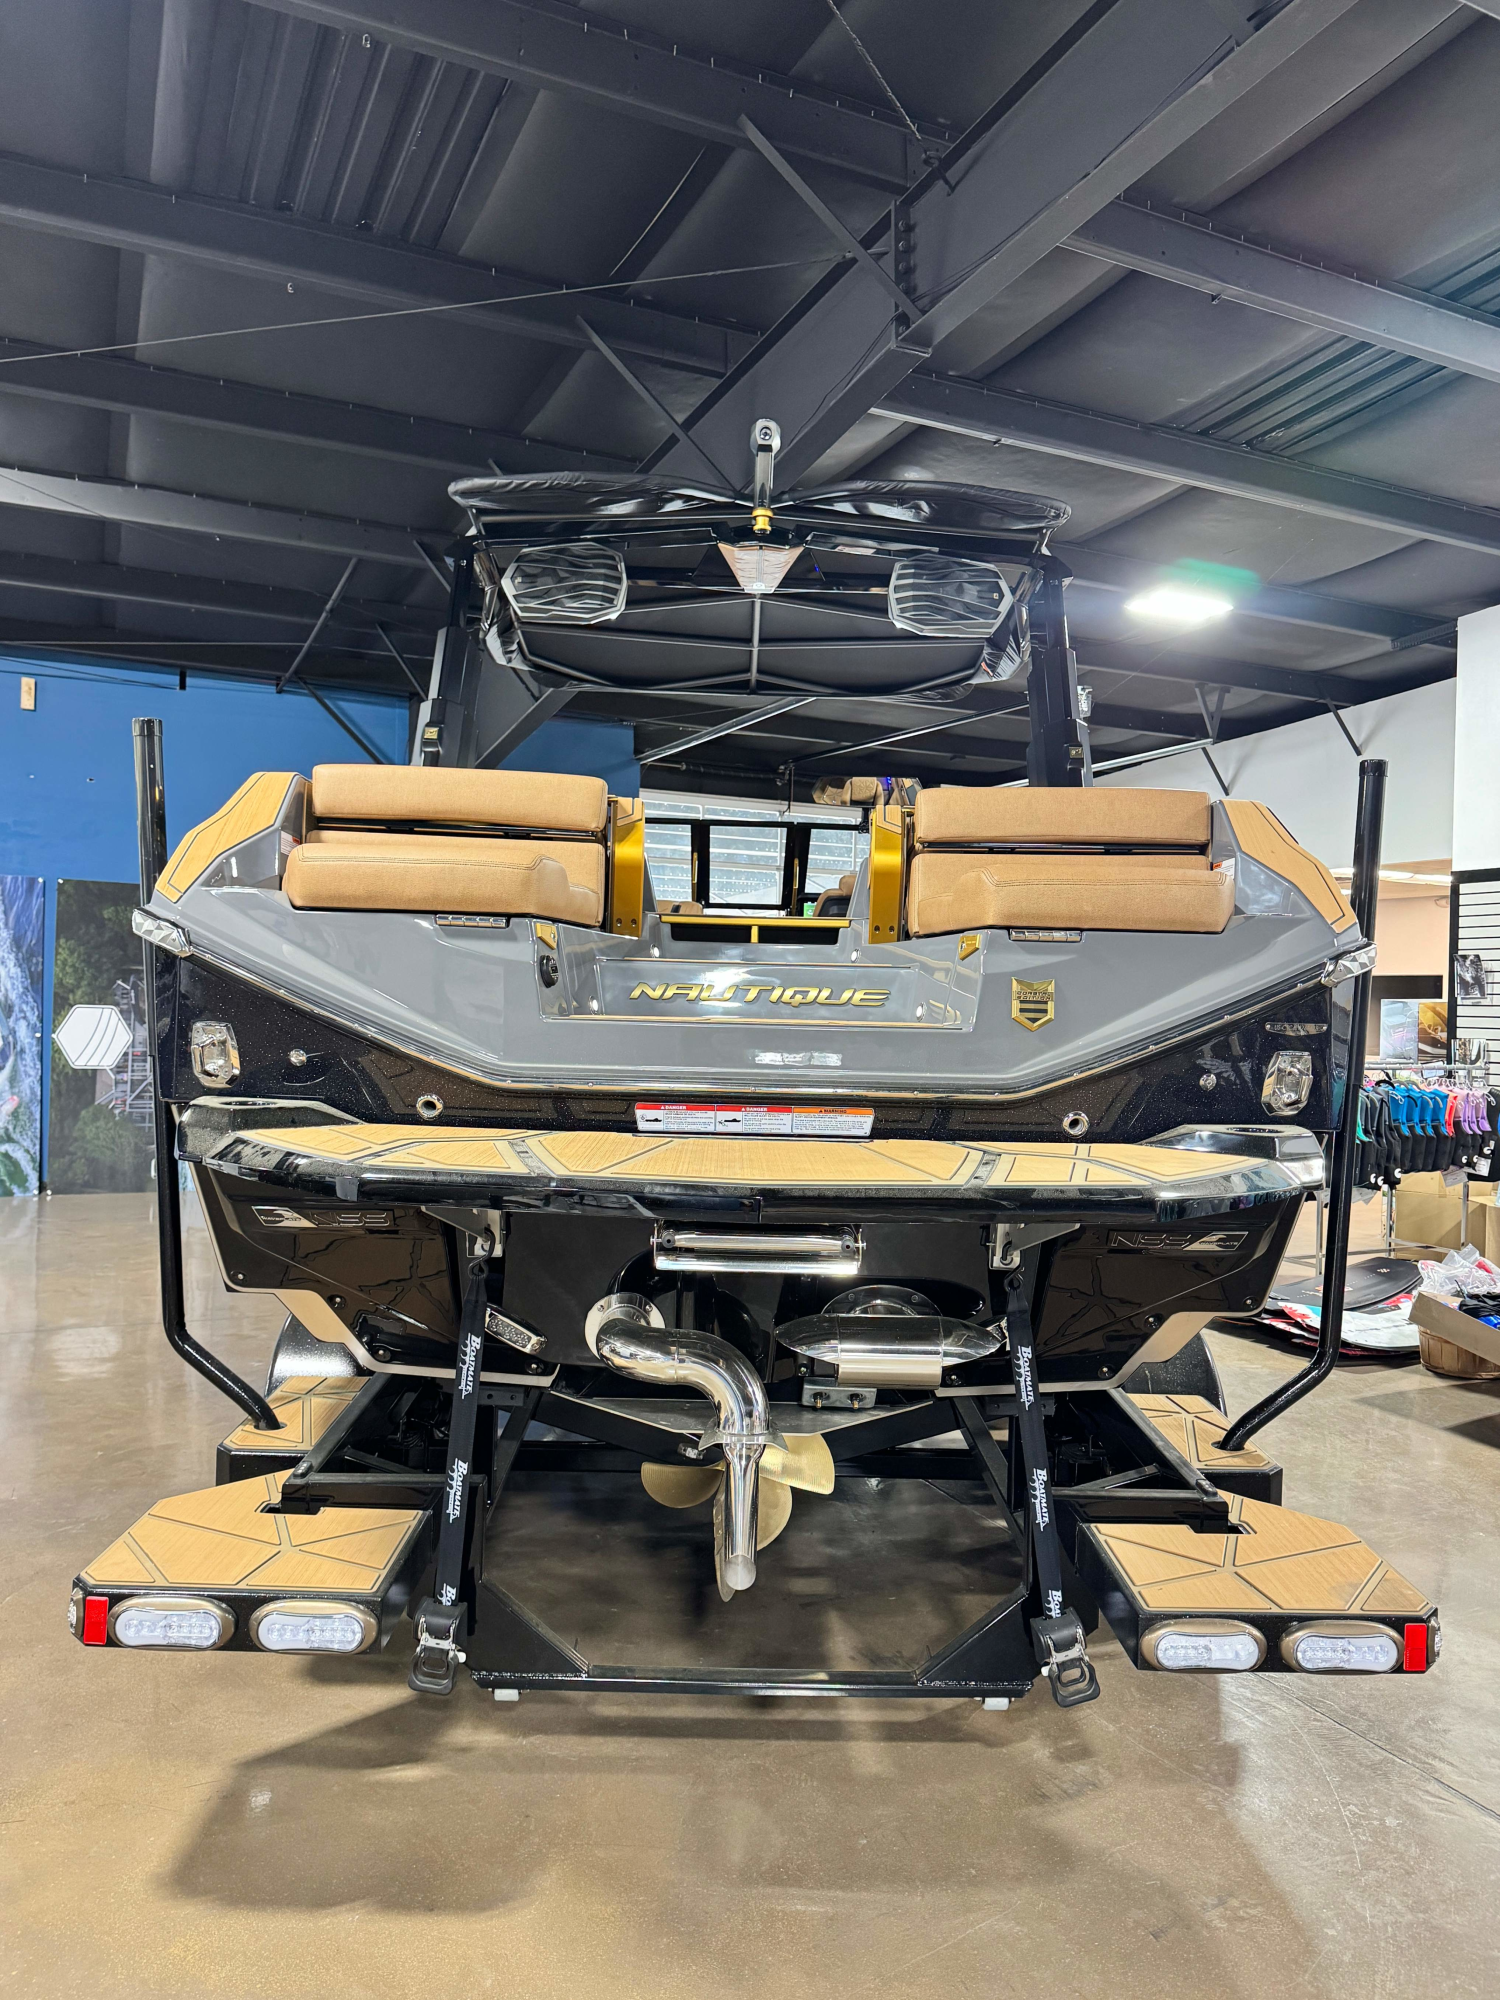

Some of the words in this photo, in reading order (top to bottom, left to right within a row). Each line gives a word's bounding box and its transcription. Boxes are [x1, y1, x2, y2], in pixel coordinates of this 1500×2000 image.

[629, 982, 891, 1007] NAUTIQUE
[465, 1334, 481, 1394] BOATMATE
[1021, 1345, 1035, 1404] BOATMATE
[453, 1459, 468, 1518] BOATMATE
[1036, 1467, 1050, 1524] BOATMATE
